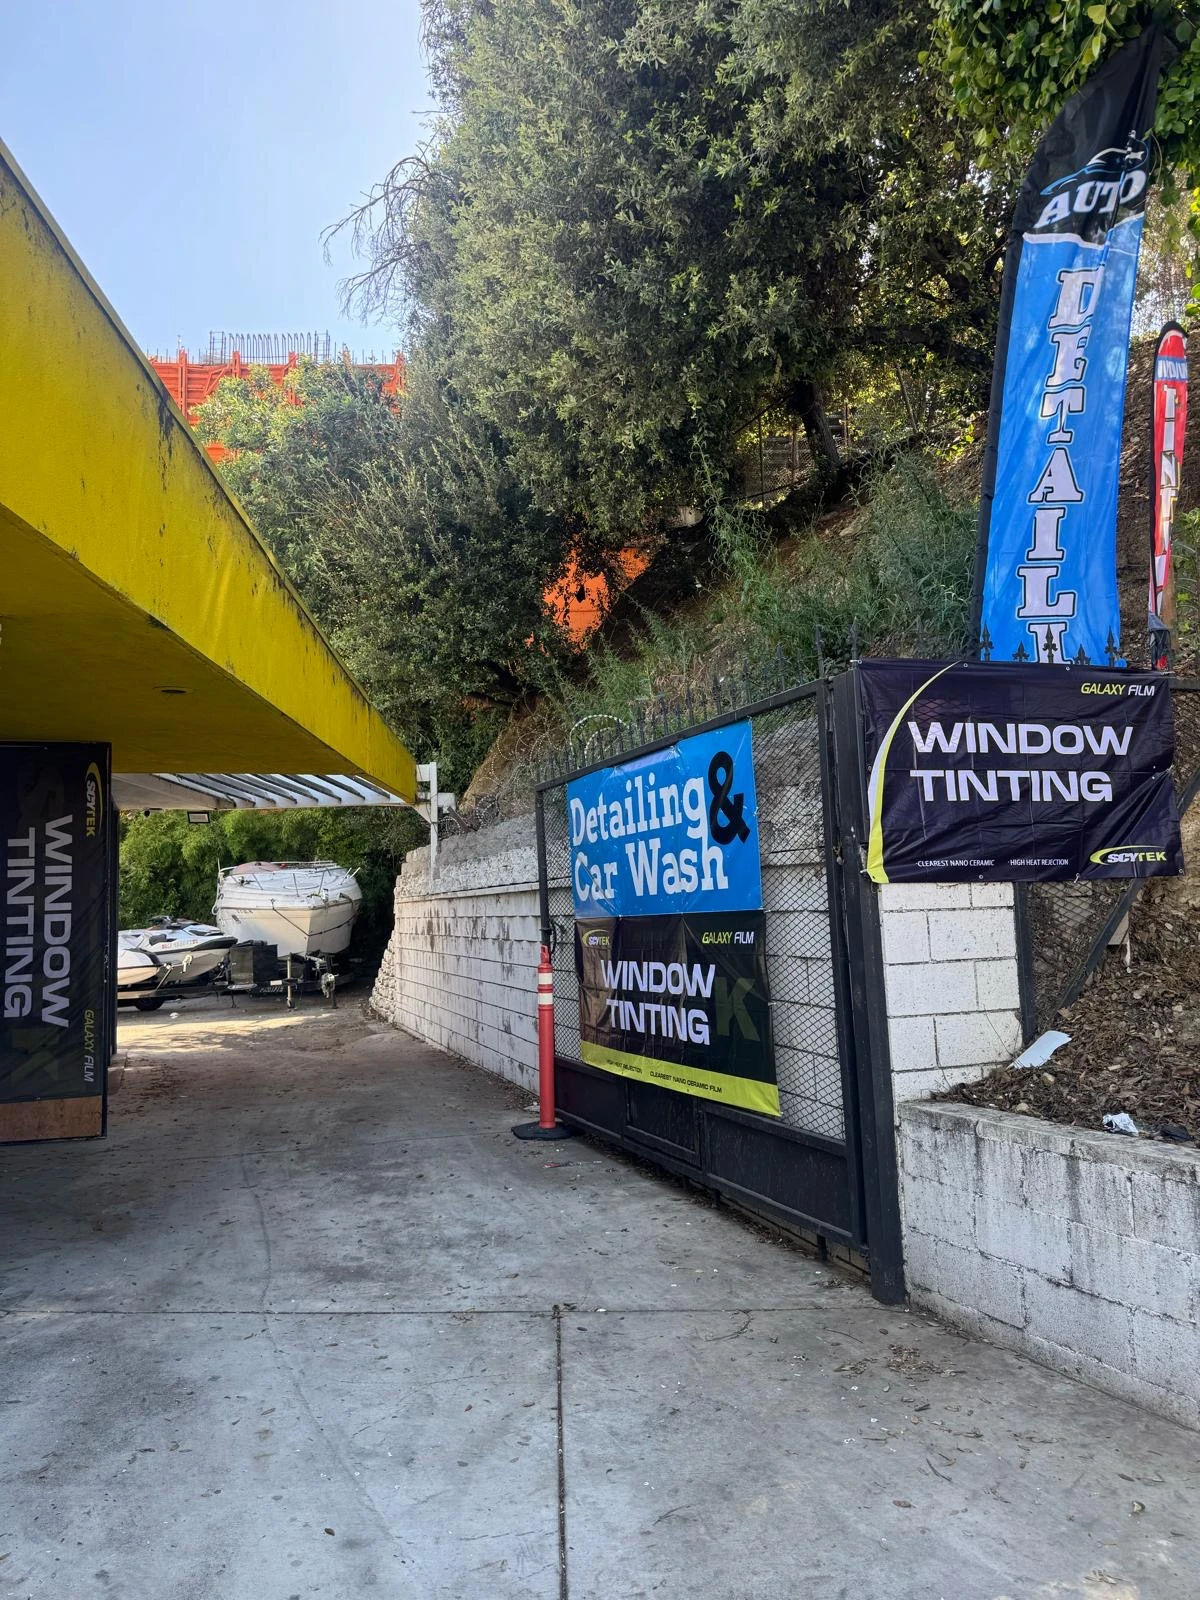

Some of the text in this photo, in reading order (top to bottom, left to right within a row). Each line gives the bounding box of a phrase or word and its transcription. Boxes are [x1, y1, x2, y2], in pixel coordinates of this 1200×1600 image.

[1034, 170, 1146, 228] AUTO
[1081, 682, 1155, 697] GALAXY FILM
[908, 721, 1133, 755] WINDOW
[570, 751, 751, 846] Detailing &
[910, 770, 1112, 802] TINTING
[86, 780, 97, 837] SCYTEK
[575, 835, 729, 902] Car Wash
[917, 859, 995, 867] CLEAREST NANO CERAMIC
[1010, 858, 1069, 866] HIGH HEAT REJECTION
[1106, 850, 1167, 863] SCYTEK
[3, 827, 36, 1018] TINTING
[42, 814, 73, 1028] WINDOW
[702, 931, 755, 944] GALAXY FILM
[588, 936, 610, 946] SCYTEK
[601, 960, 716, 998] WINDOW
[606, 999, 710, 1046] TINTING
[83, 1009, 94, 1082] GALAXY FILM
[673, 1076, 686, 1085] NANO
[687, 1079, 709, 1090] CERAMIC
[710, 1085, 723, 1093] FILM
